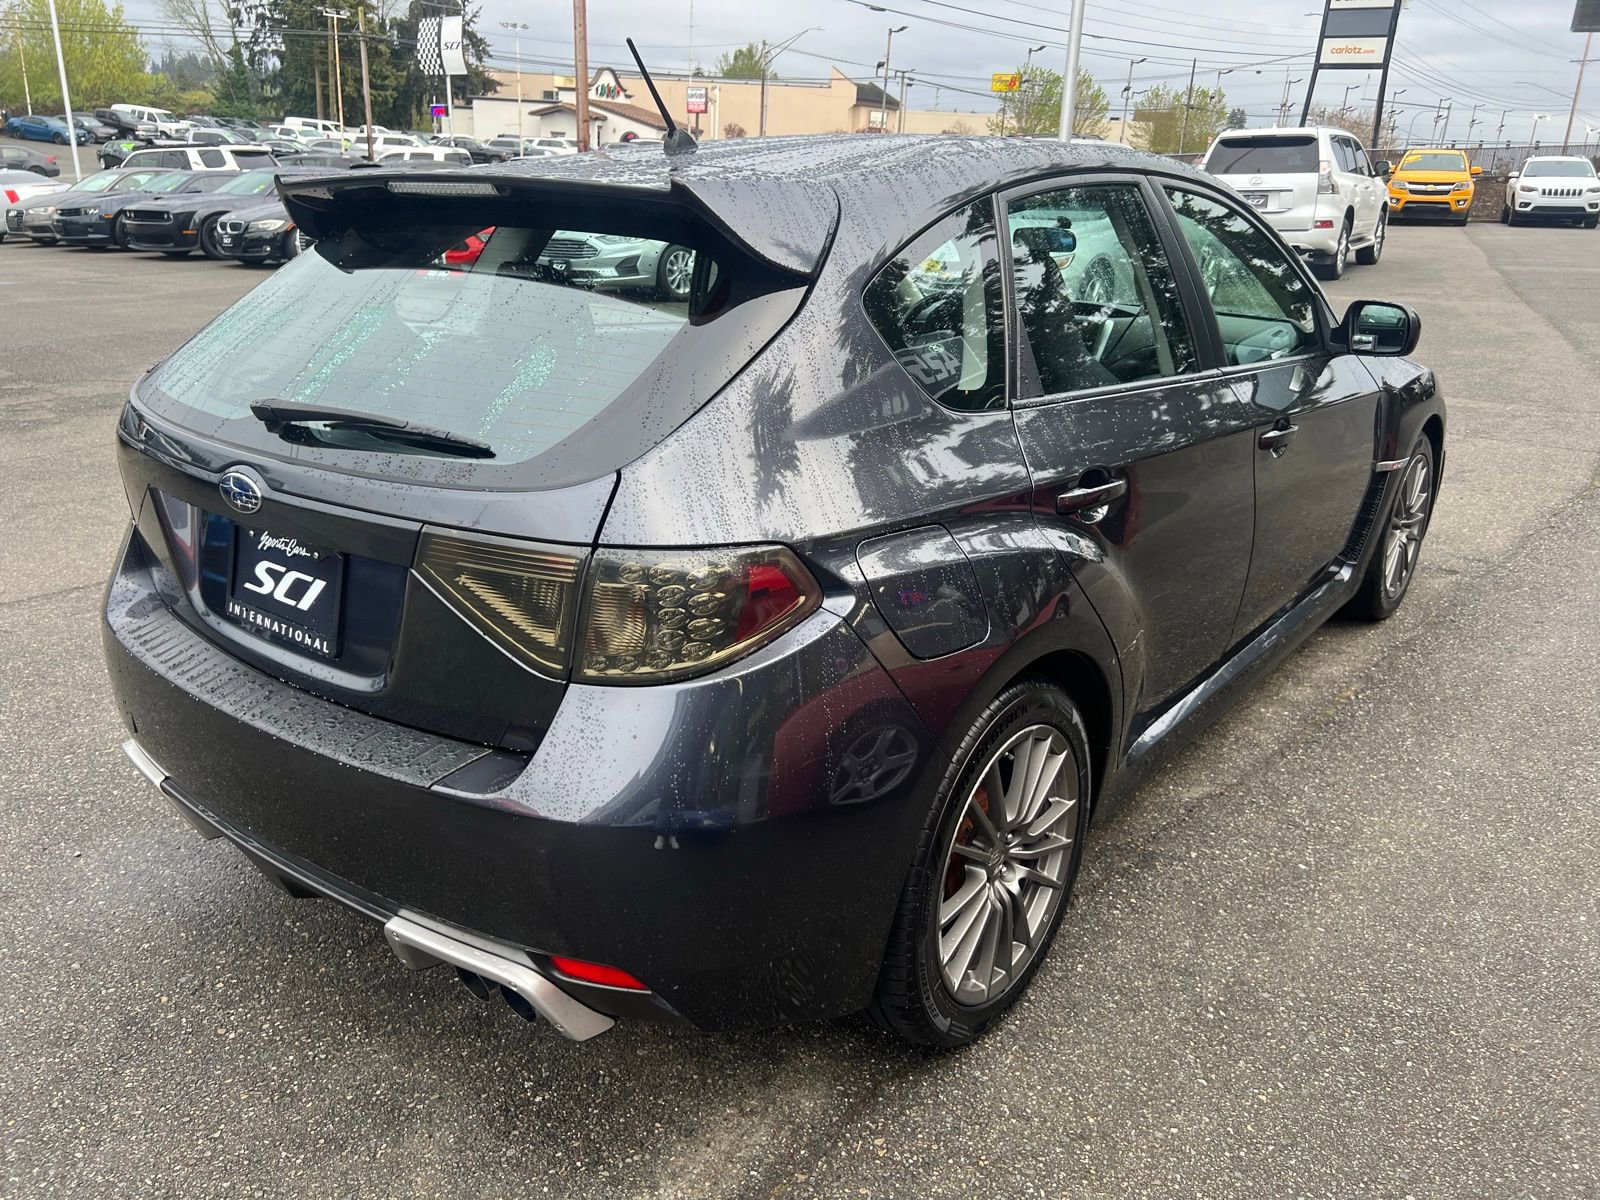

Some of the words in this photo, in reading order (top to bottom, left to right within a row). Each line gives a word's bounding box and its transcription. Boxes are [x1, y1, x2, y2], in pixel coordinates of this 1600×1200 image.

[441, 41, 461, 51] SCI
[1330, 44, 1376, 55] carlotz.com
[257, 530, 290, 551] Sports
[285, 538, 311, 557] Cars
[243, 560, 327, 611] SCI
[229, 601, 330, 654] INTERNATIONAL
